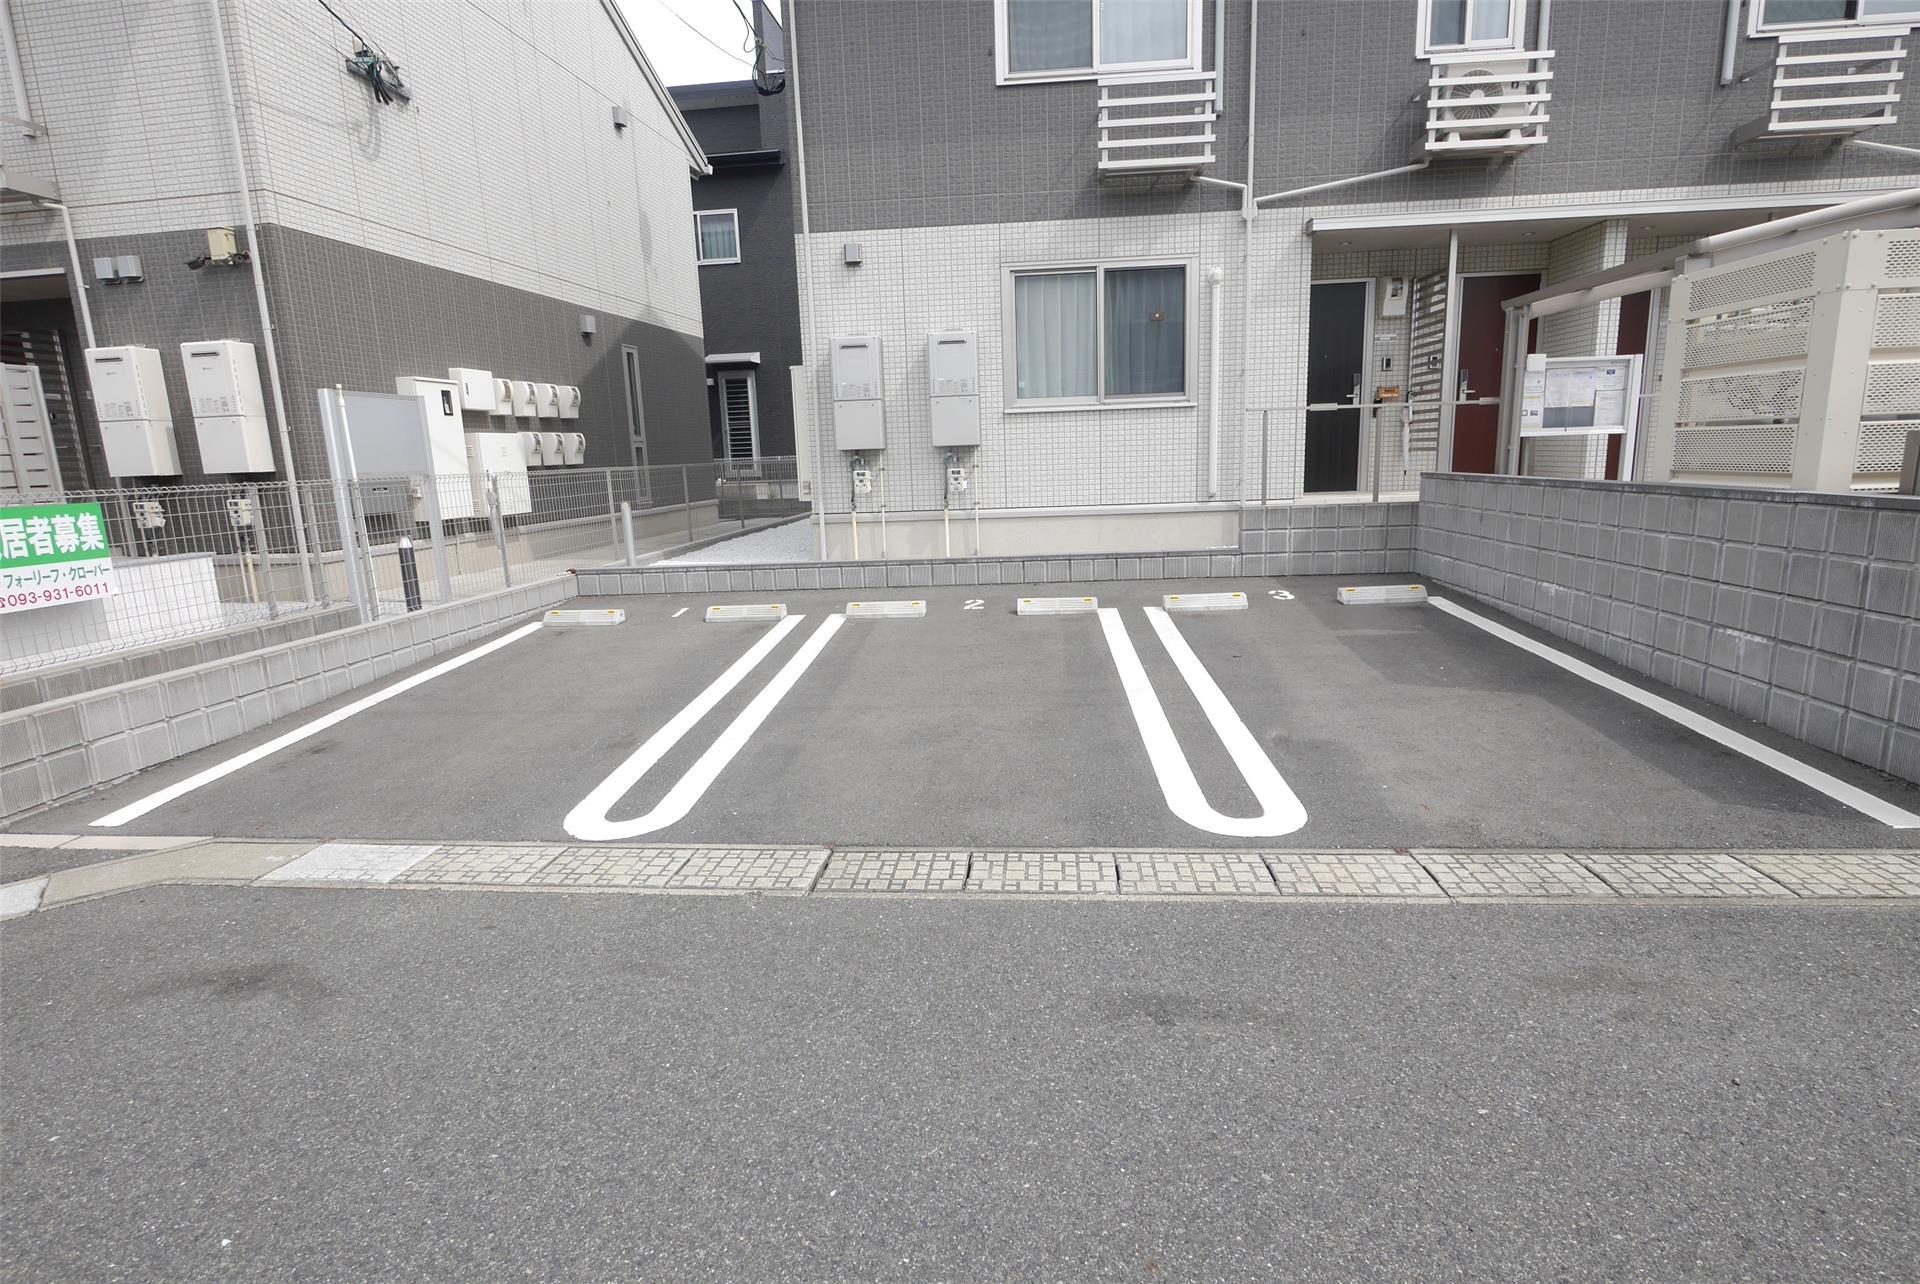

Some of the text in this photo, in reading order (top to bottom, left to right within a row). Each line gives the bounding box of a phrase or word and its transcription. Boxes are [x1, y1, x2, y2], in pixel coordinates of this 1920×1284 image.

[0, 512, 104, 559] 居者募集
[7, 582, 109, 607] 093-931-6011
[1268, 589, 1296, 600] 3
[963, 599, 985, 610] 2
